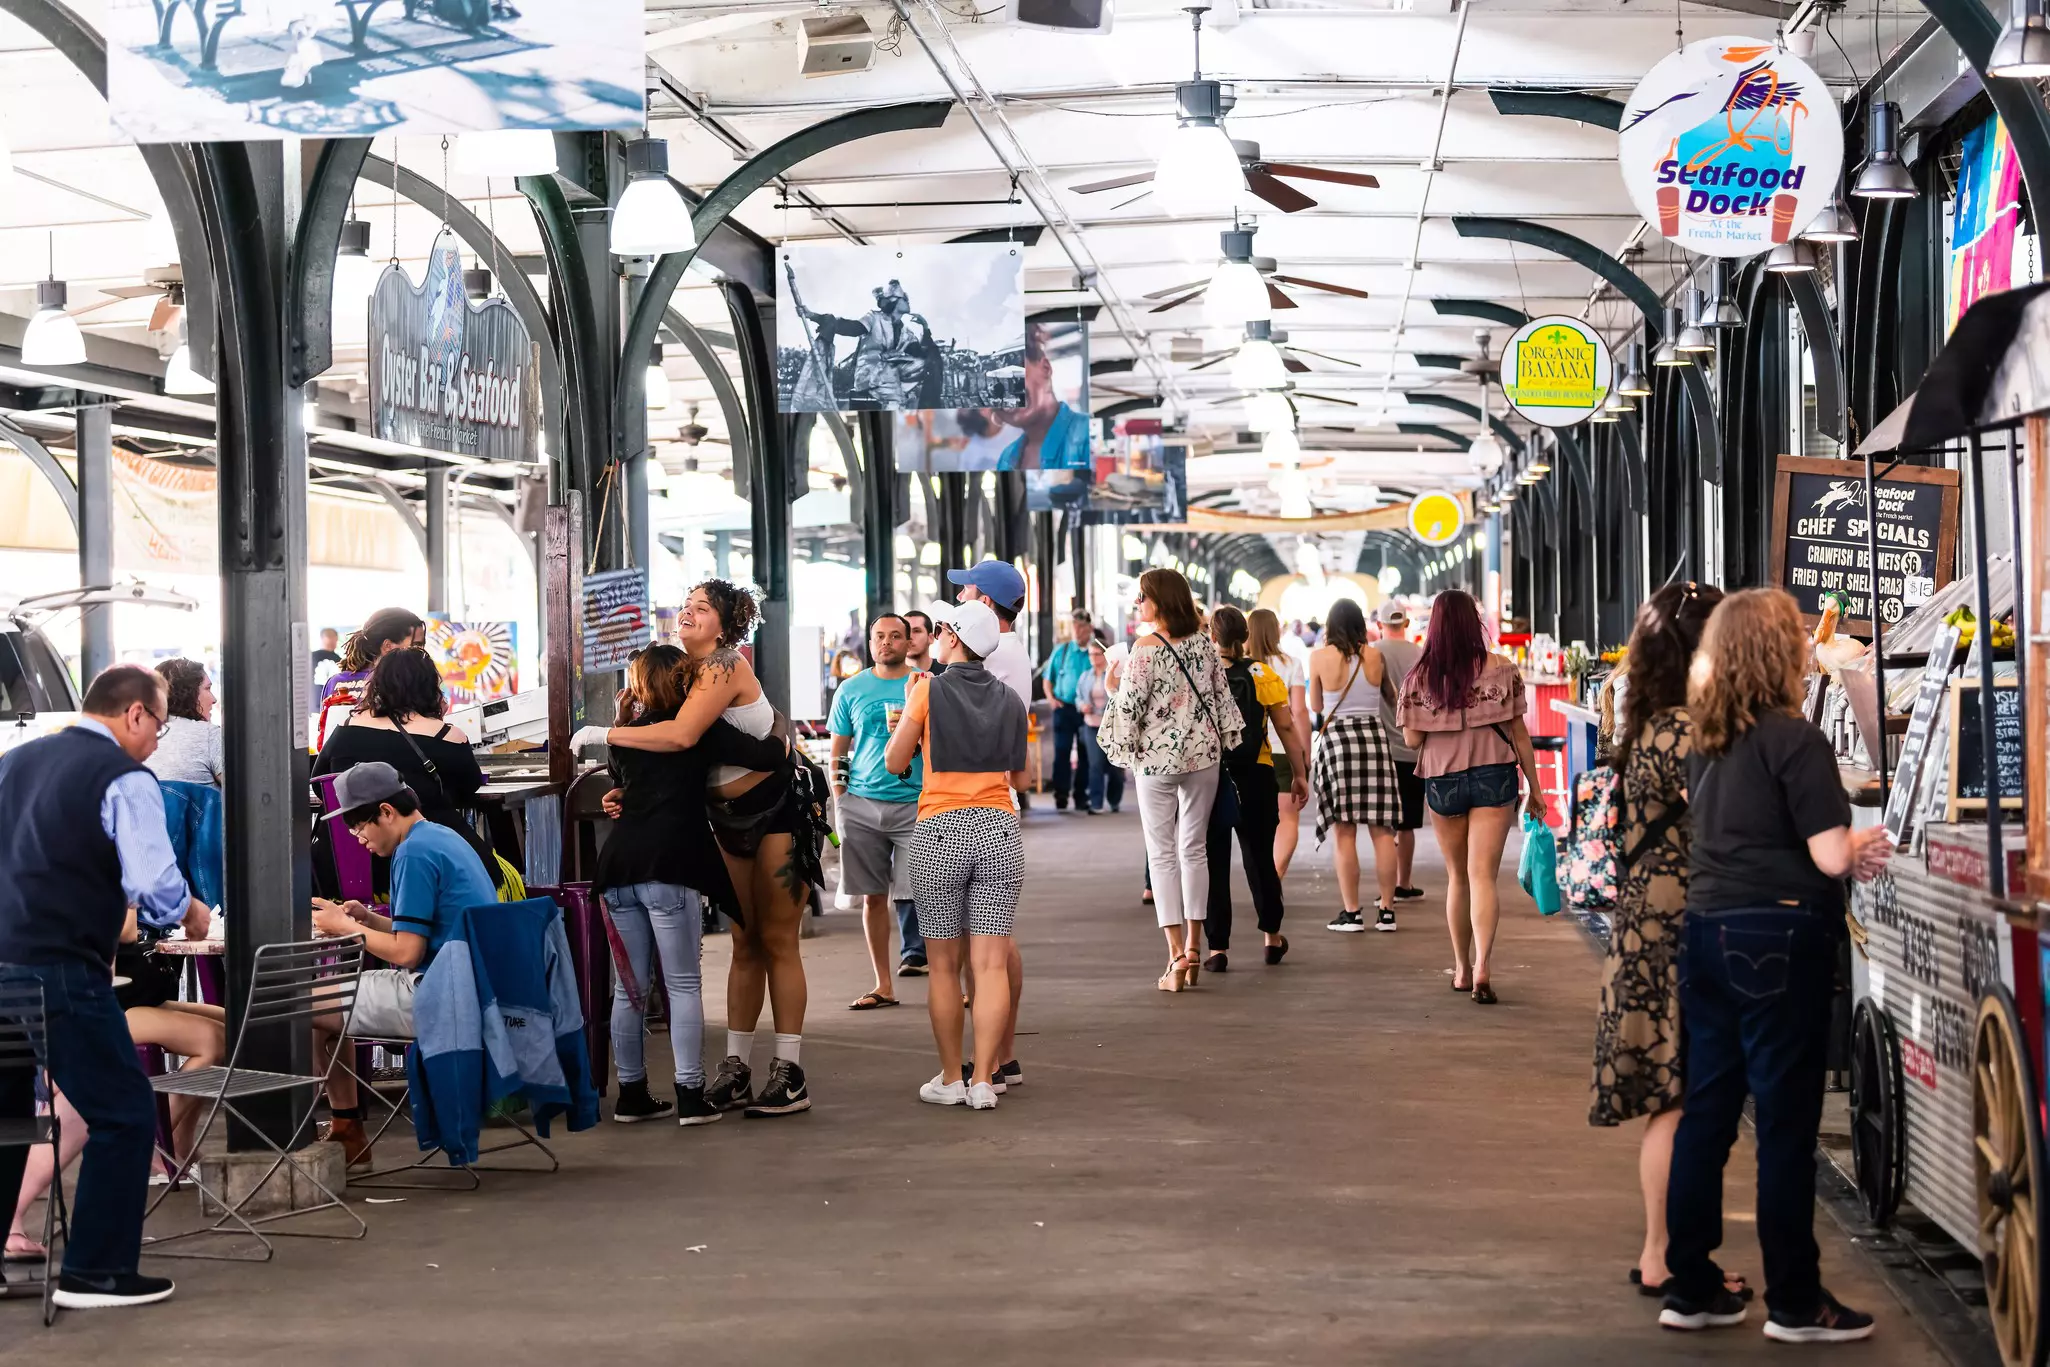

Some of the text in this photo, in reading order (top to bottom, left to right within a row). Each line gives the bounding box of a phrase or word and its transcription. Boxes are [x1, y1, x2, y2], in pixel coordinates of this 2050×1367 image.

[1657, 160, 1806, 190] Seafood
[1685, 189, 1773, 217] Dock
[1688, 229, 1762, 241] French Market
[1522, 345, 1591, 361] ORGANIC
[381, 332, 521, 428] Oyster Bar & Seafood
[1521, 360, 1591, 379] BANANA
[430, 422, 451, 441] French
[452, 427, 478, 446] Market
[1877, 499, 1905, 512] Dock
[1797, 517, 1930, 549] CHEF SPCIALS
[1807, 545, 1917, 576] CRAWFISH BENETS $6
[1792, 567, 1818, 587] FRIED
[1821, 570, 1844, 590] SOFT
[1886, 598, 1899, 620] $5
